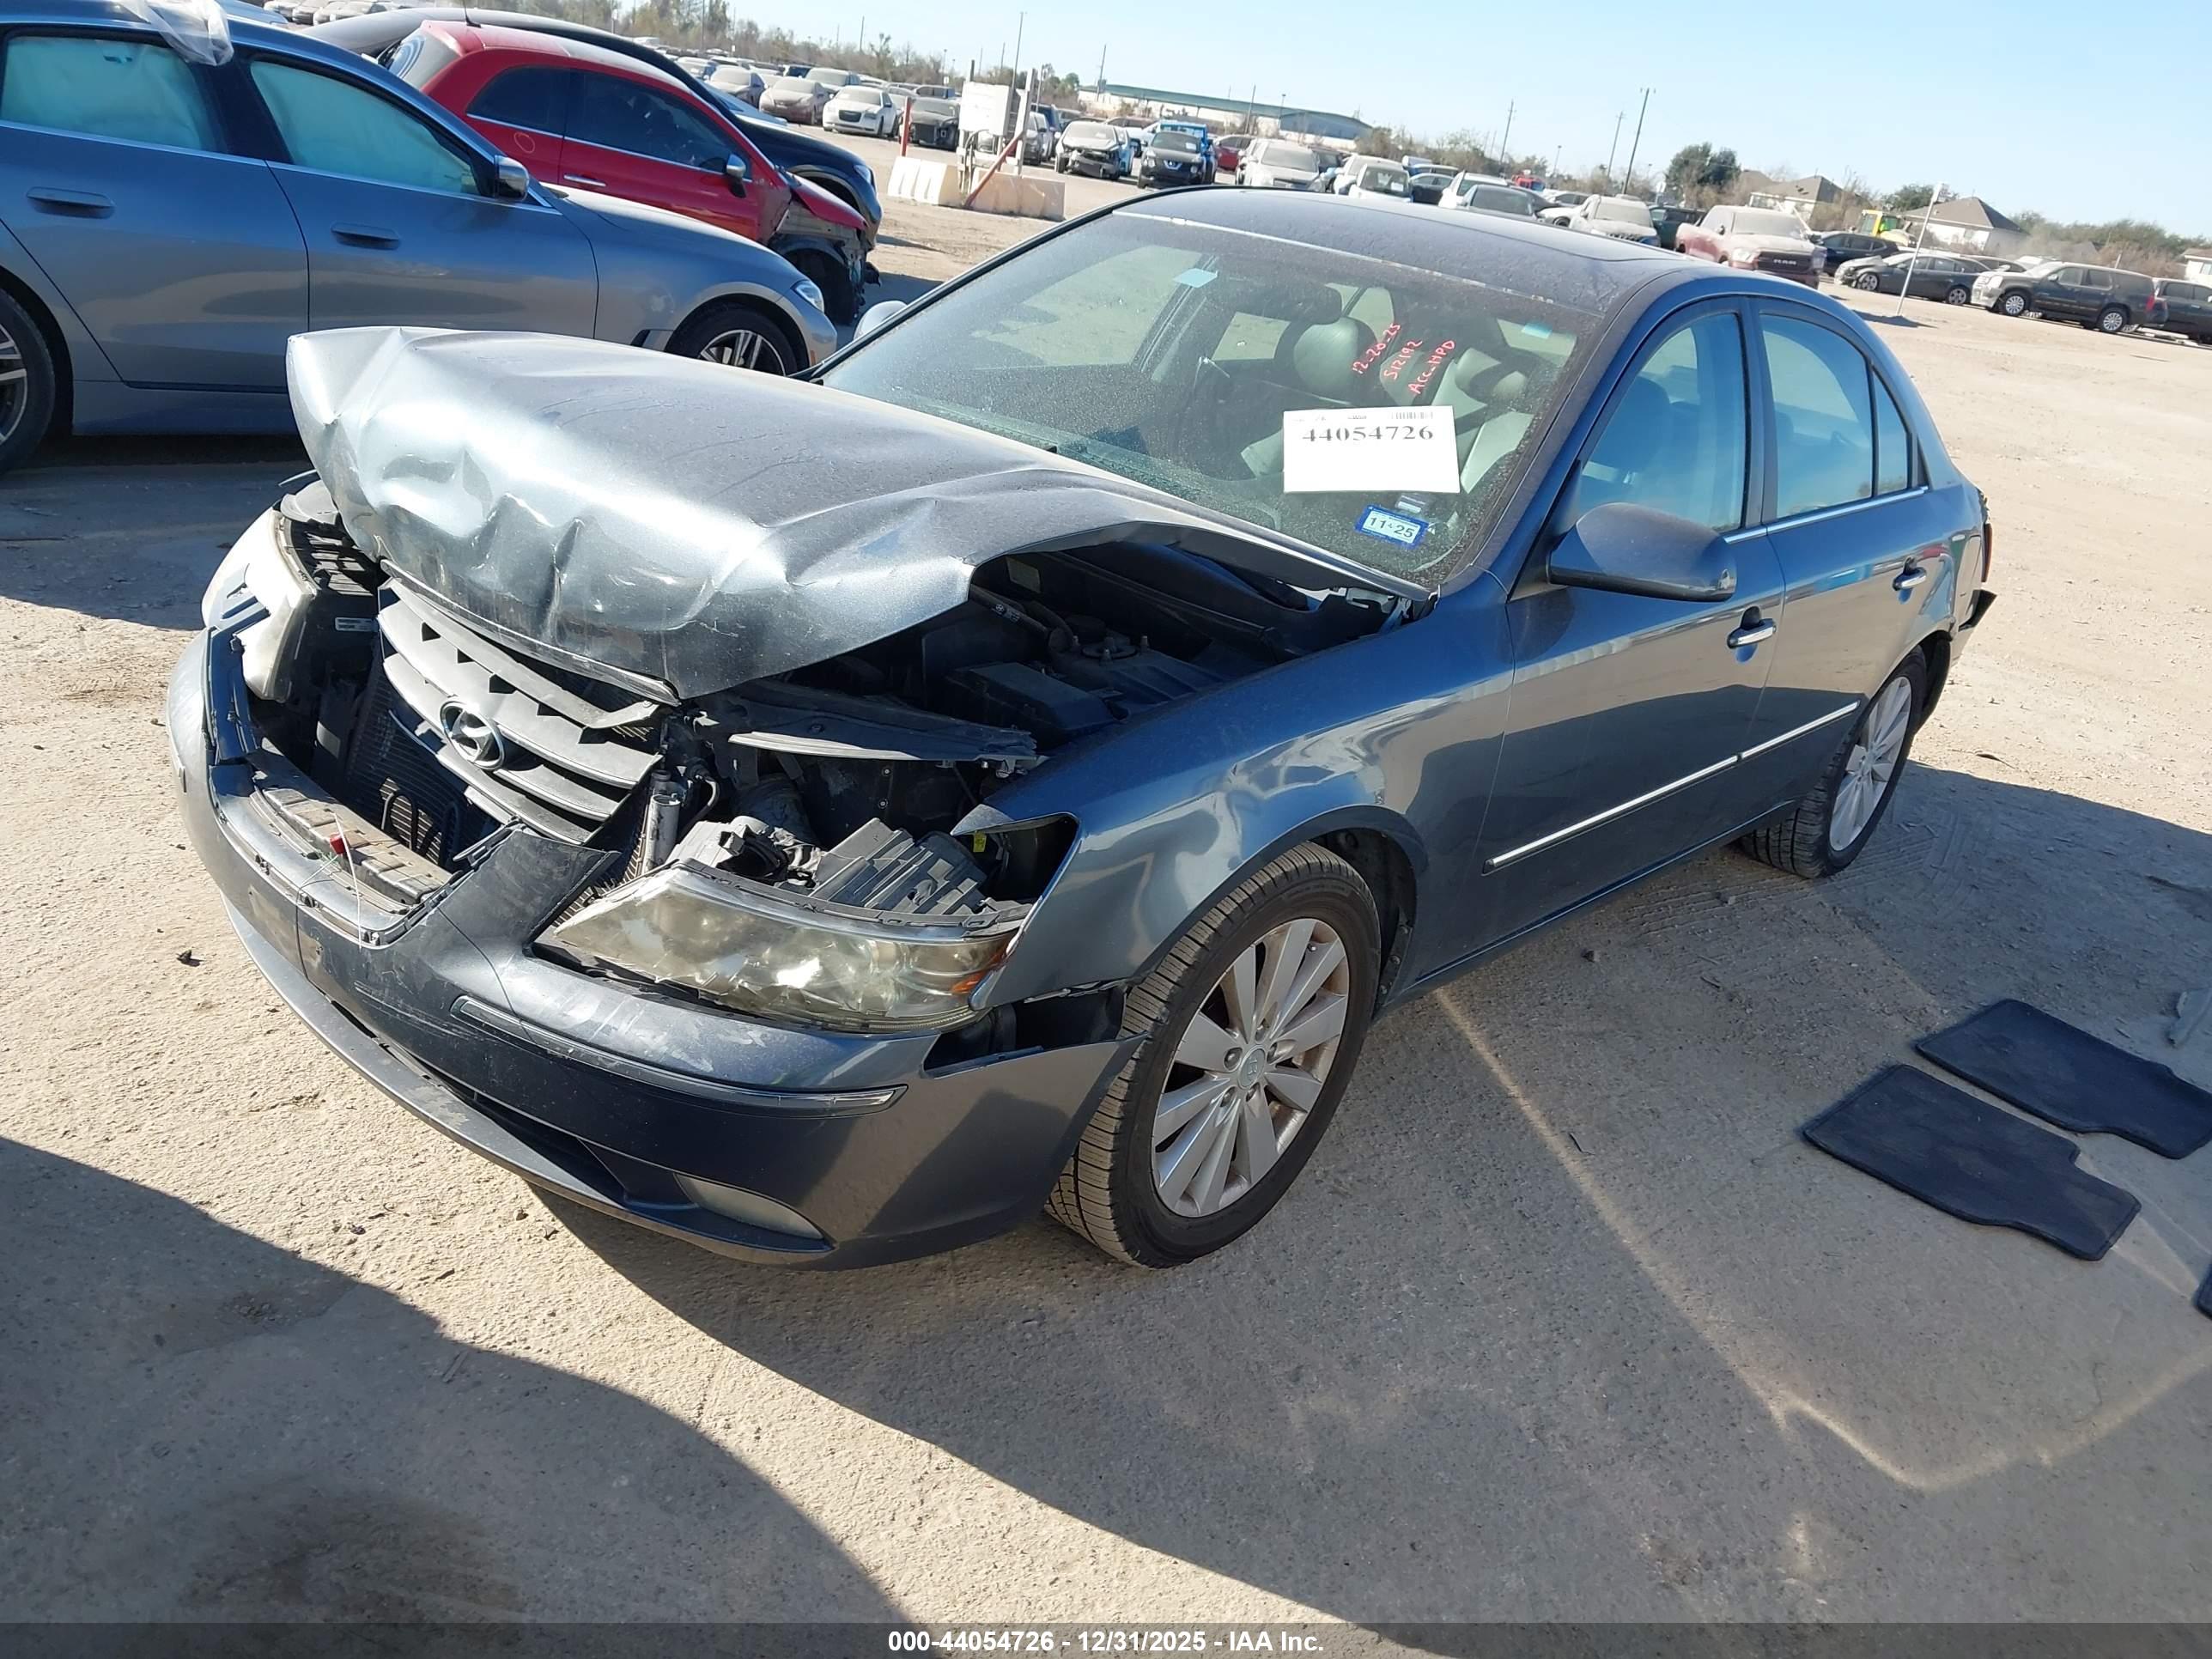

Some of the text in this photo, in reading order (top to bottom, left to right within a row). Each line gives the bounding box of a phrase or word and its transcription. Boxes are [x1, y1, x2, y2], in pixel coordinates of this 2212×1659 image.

[1302, 425, 1434, 442] 44054726
[1370, 517, 1387, 529] 11
[1394, 524, 1415, 538] 25
